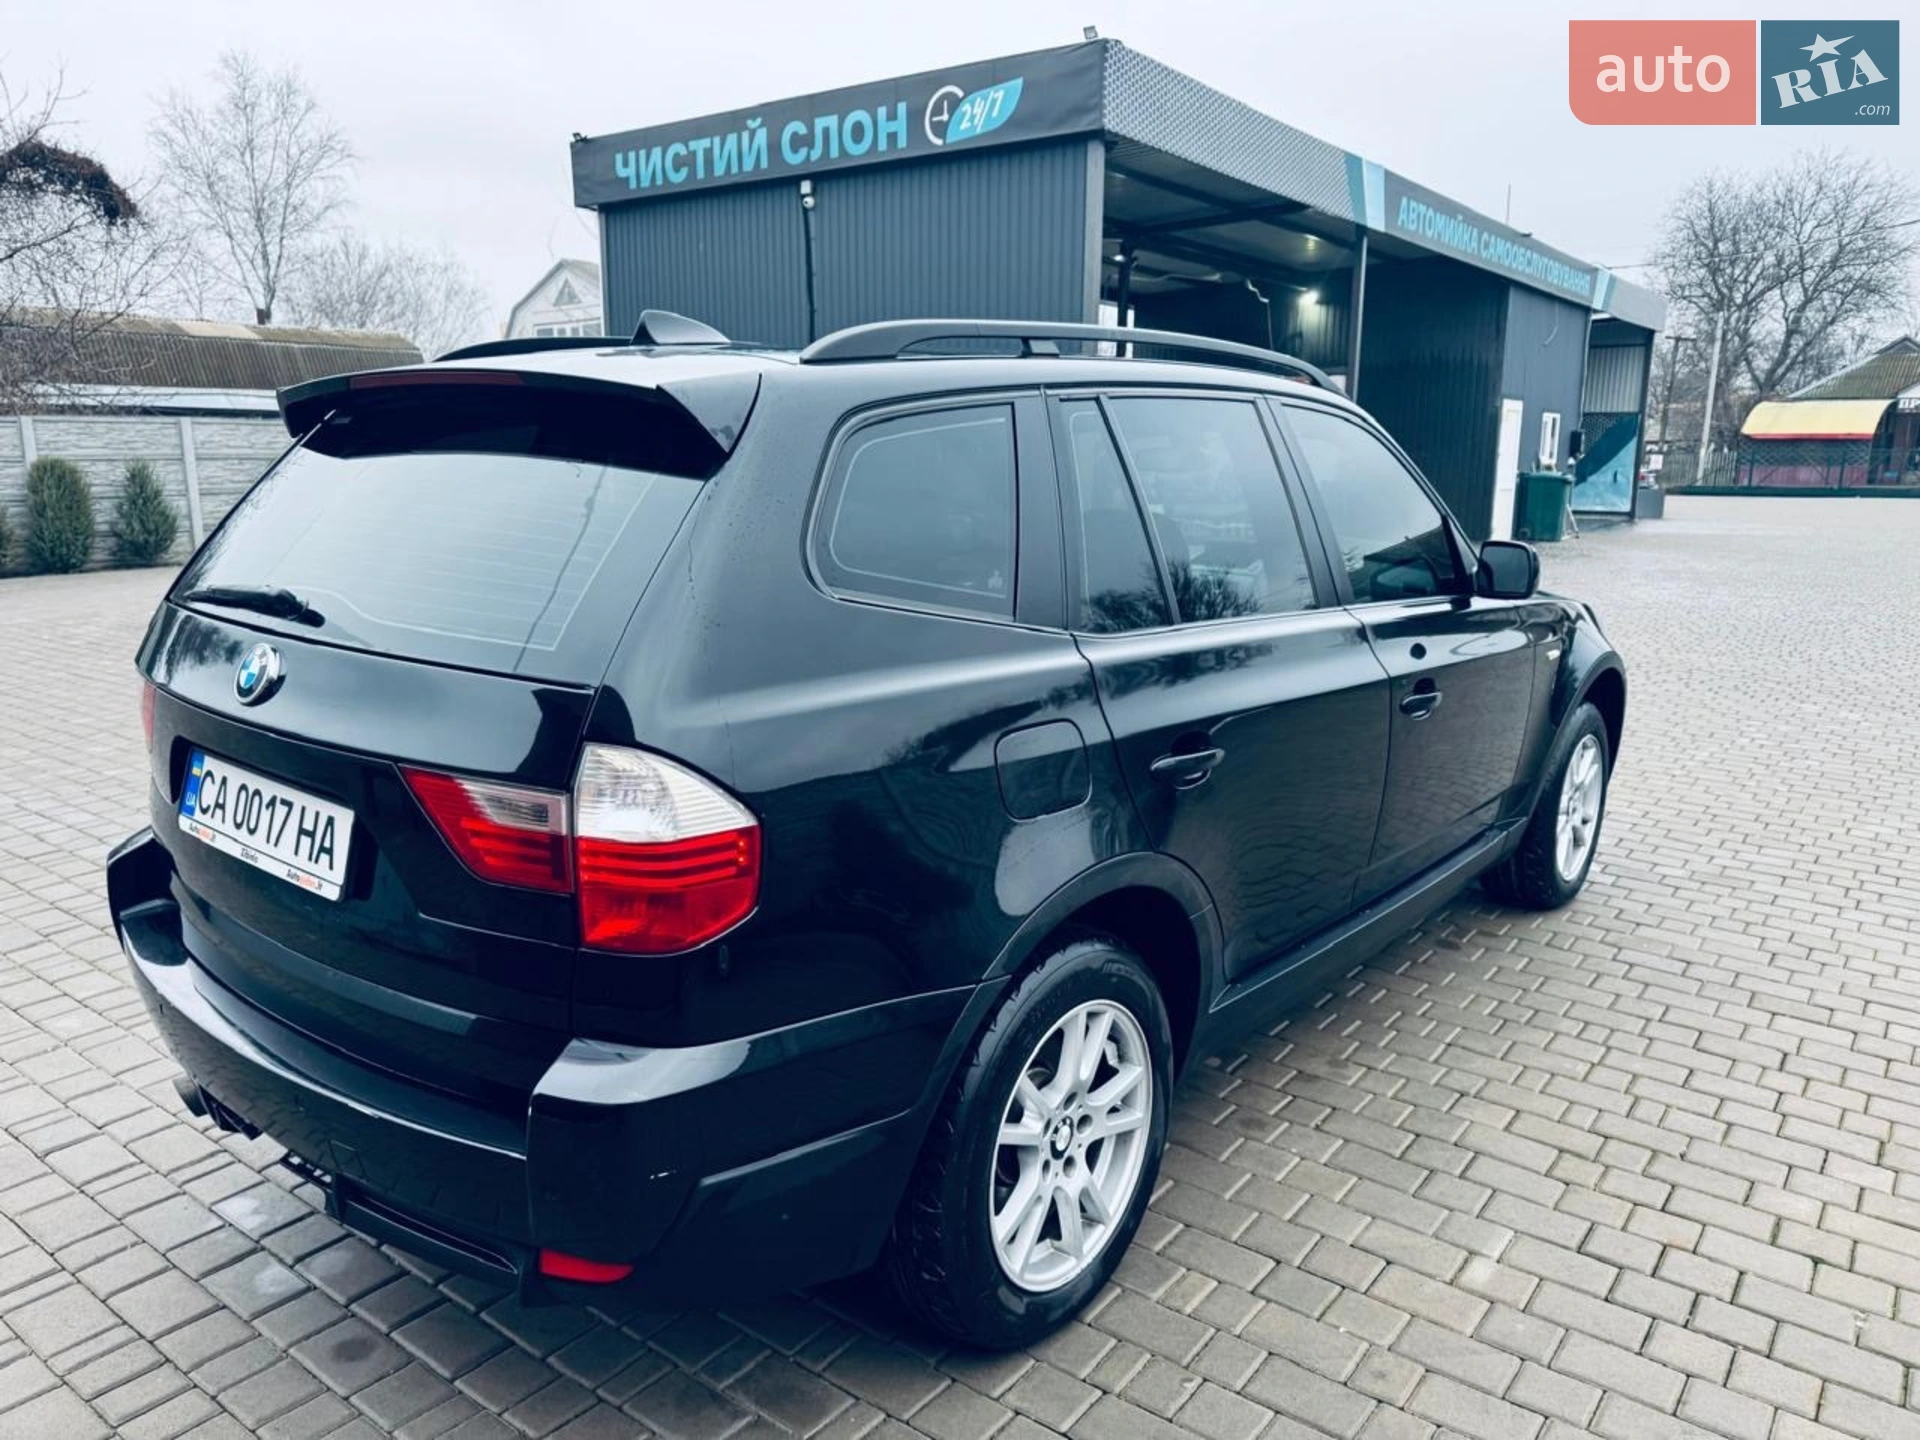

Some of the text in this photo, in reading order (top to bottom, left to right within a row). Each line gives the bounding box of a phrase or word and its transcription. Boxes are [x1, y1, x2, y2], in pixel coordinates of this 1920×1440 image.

[615, 90, 1005, 190] ЧИСТИЙ СЛОН 24/7
[1397, 196, 1478, 255] АВТОМИЙКА
[199, 769, 336, 872] CA 0017 HA
